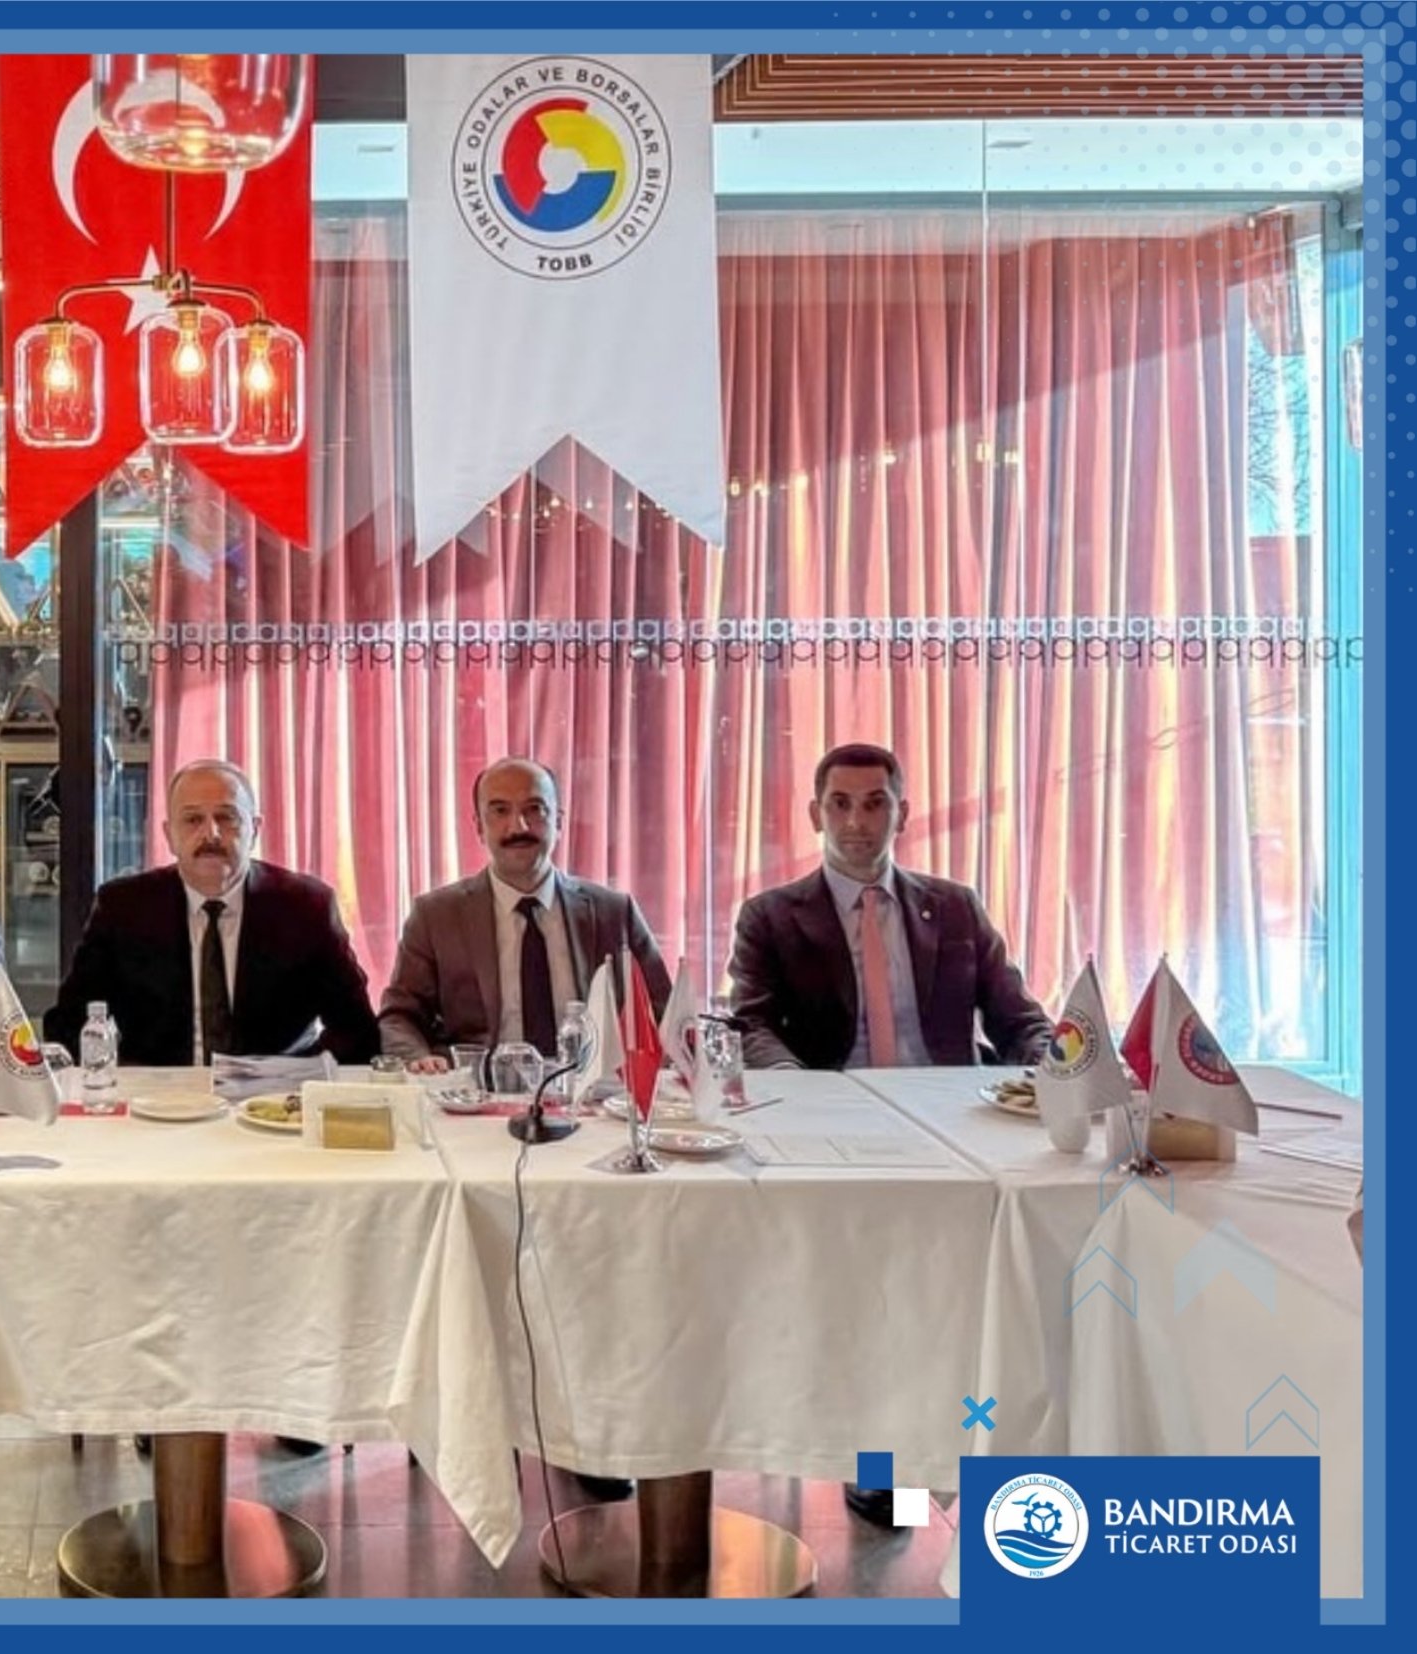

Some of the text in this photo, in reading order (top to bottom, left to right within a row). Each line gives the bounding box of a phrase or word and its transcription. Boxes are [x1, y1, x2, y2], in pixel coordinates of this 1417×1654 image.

[538, 67, 565, 82] VE
[467, 77, 529, 149] ODALAR
[576, 69, 660, 156] BORSALAR
[463, 162, 508, 250] TÜRKİYE
[537, 254, 593, 271] TOBB
